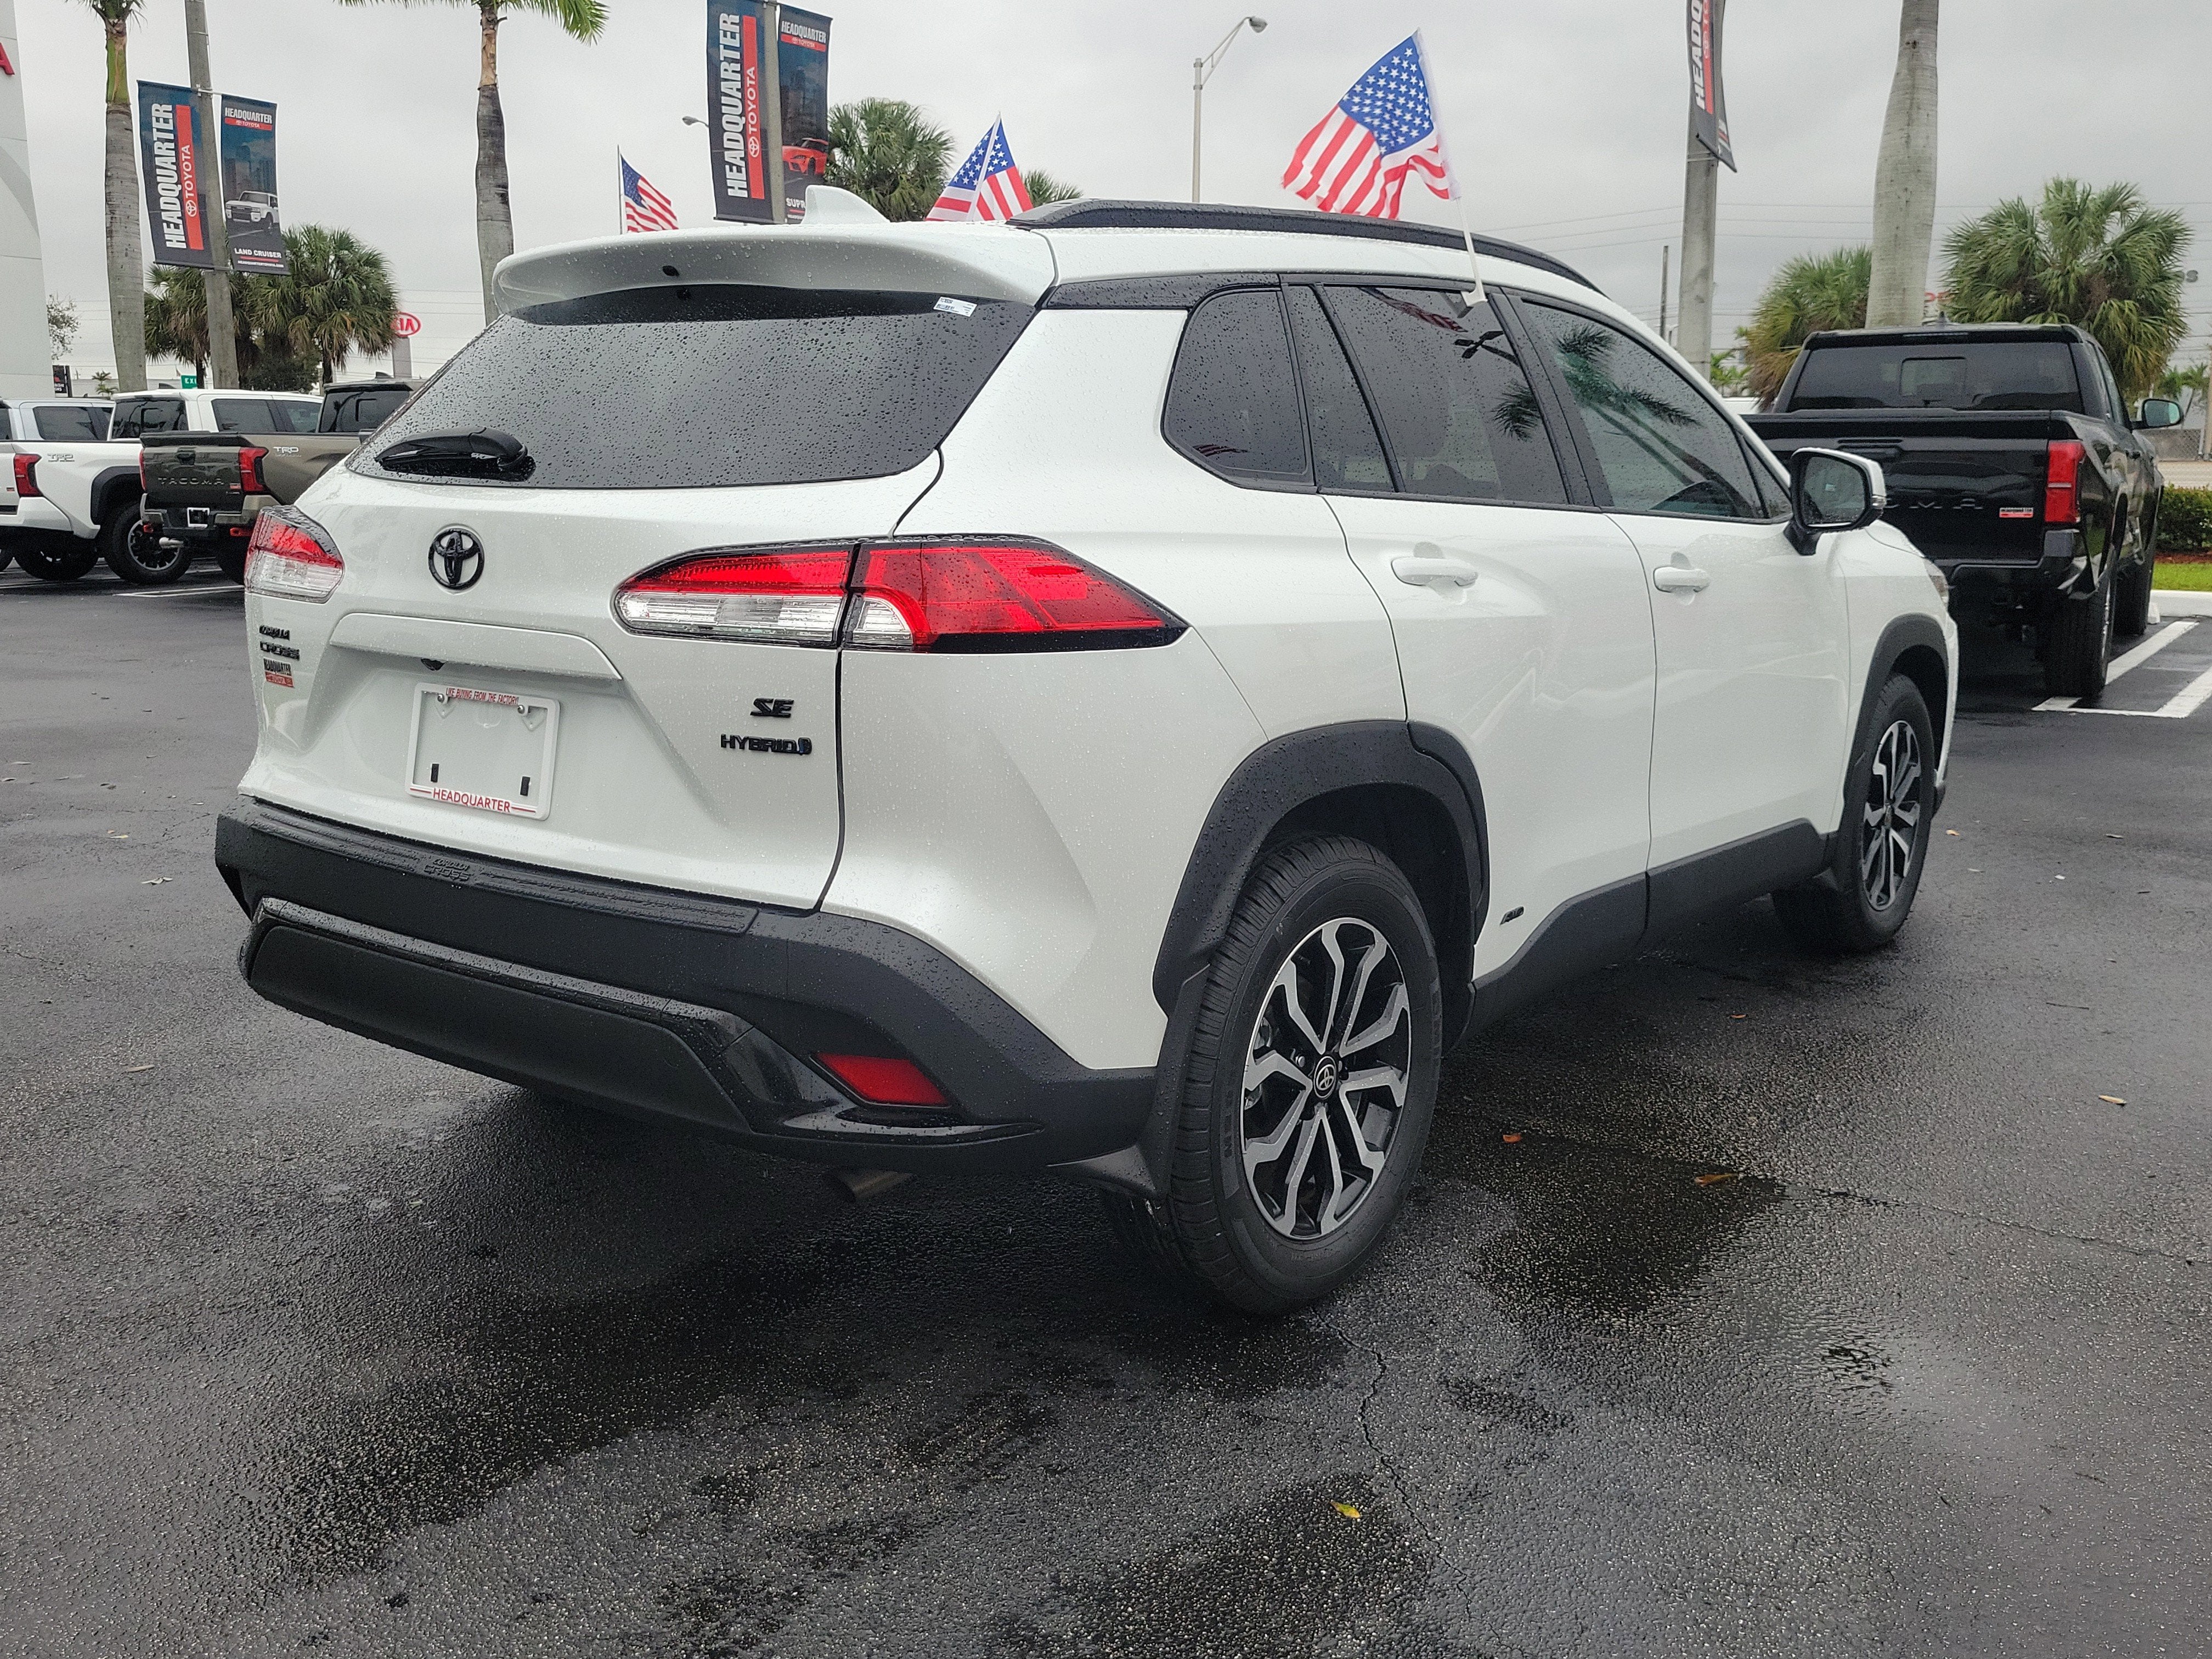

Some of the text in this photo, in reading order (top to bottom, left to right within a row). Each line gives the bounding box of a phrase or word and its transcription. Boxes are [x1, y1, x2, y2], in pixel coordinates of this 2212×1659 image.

[781, 21, 826, 43] HEADQUARTER
[719, 13, 748, 198] HEADQUARTER
[746, 66, 758, 134] TOYOTA
[225, 107, 272, 124] HEADQUARTER
[151, 103, 187, 249] HEADQUARTER
[182, 145, 195, 198] TOYOTA
[786, 198, 805, 208] SUPR
[253, 250, 281, 258] CRUISER
[750, 698, 794, 718] SE
[721, 733, 798, 754] HYBRID
[433, 788, 511, 813] HEADQUARTER
[424, 865, 471, 882] CROSS
